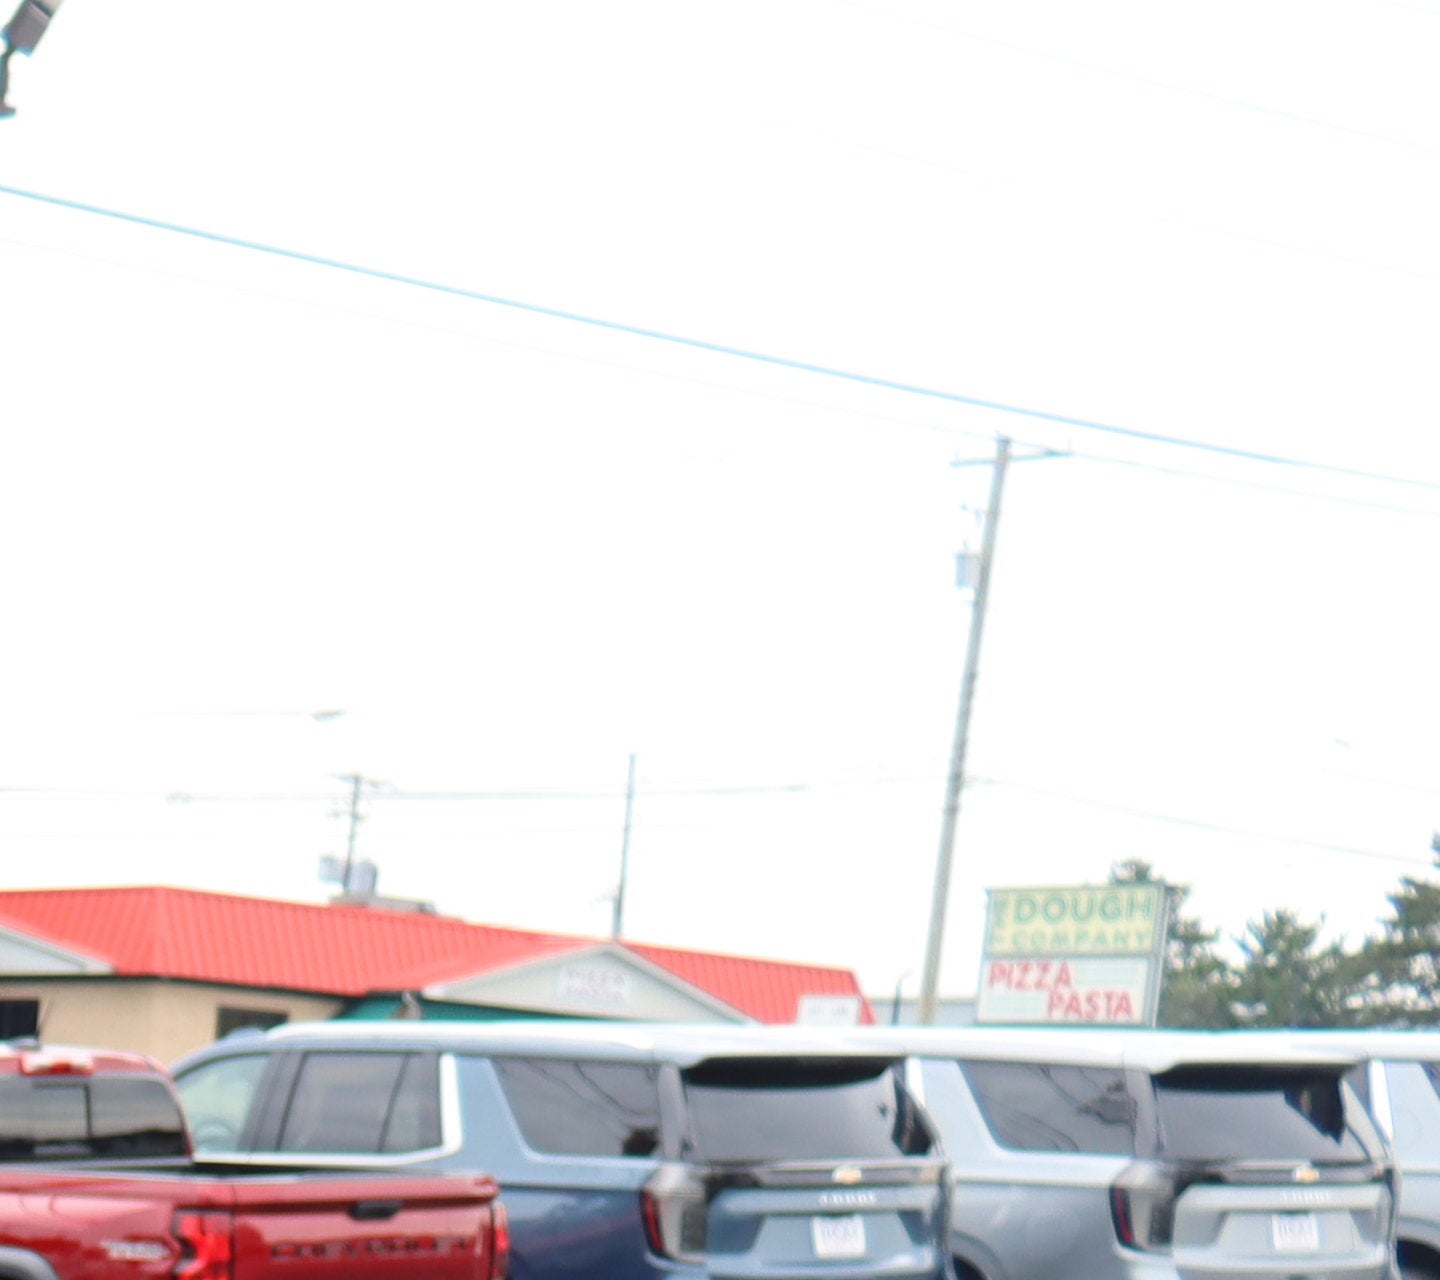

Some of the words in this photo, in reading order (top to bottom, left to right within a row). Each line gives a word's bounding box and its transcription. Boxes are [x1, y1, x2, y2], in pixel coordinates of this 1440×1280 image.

[1015, 893, 1152, 924] DOUGH
[989, 961, 1073, 990] PIZZA
[1047, 990, 1135, 1020] PASTA
